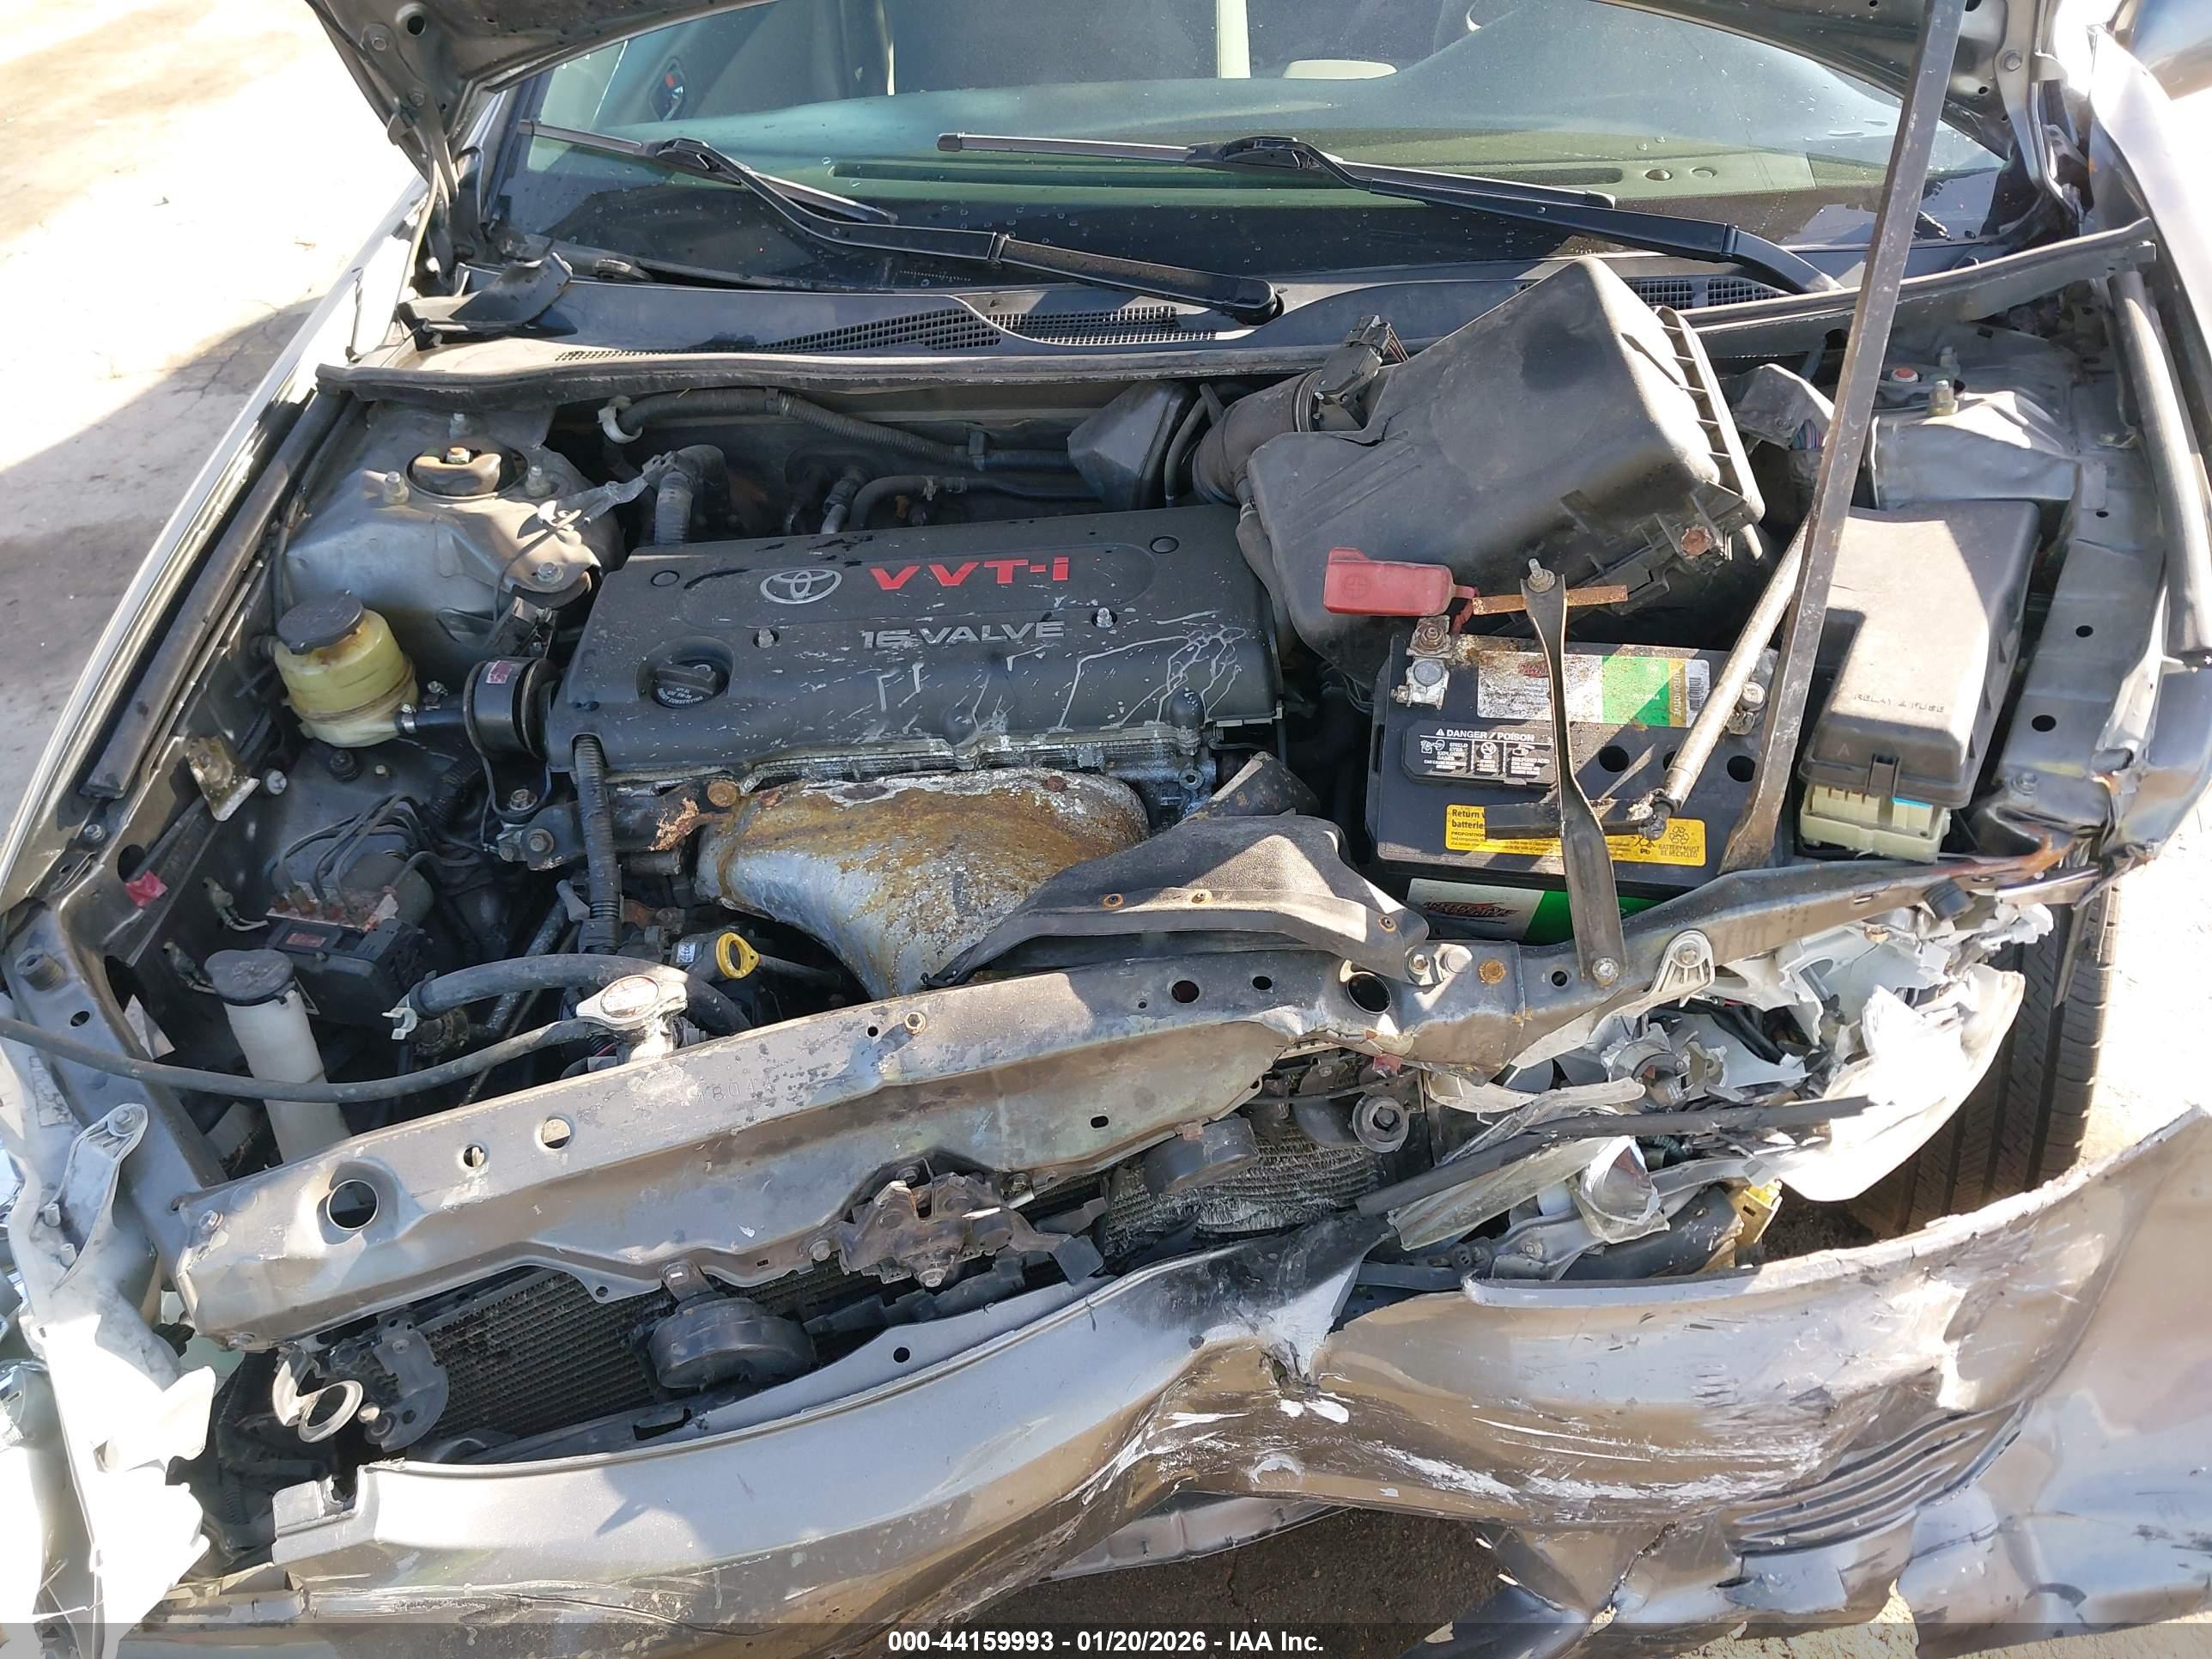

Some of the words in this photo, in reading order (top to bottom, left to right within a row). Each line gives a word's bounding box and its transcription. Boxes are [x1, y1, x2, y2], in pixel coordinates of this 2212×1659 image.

[870, 556, 1070, 591] VVT-i
[1446, 729, 1487, 739] DANGER
[1451, 809, 1480, 818] Return
[1451, 819, 1485, 830] batterie
[1658, 843, 1682, 852] BATTERY
